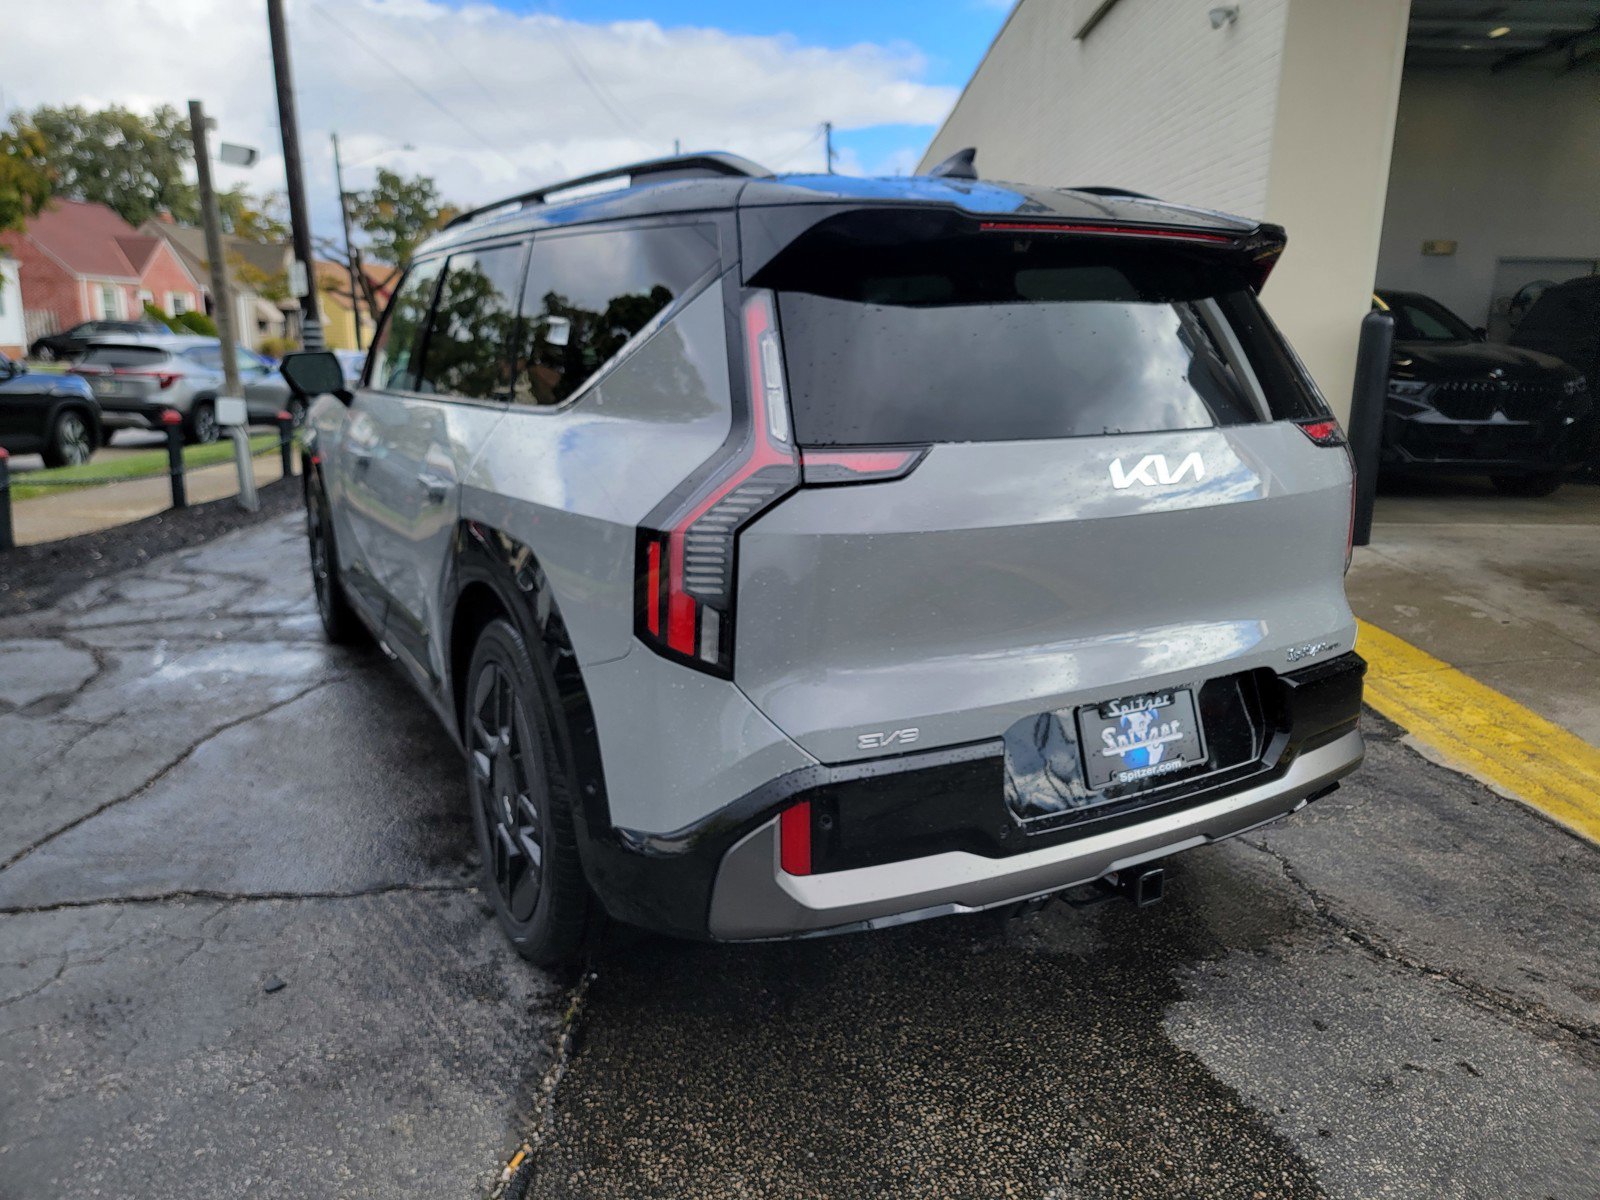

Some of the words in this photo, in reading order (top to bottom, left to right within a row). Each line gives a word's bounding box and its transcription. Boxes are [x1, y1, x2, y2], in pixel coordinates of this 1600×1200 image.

[1109, 452, 1205, 489] KIA
[1108, 694, 1171, 718] Spitzer
[858, 728, 919, 749] EV9
[1101, 719, 1183, 757] Spitzer
[1119, 759, 1182, 783] Spitzer.com
